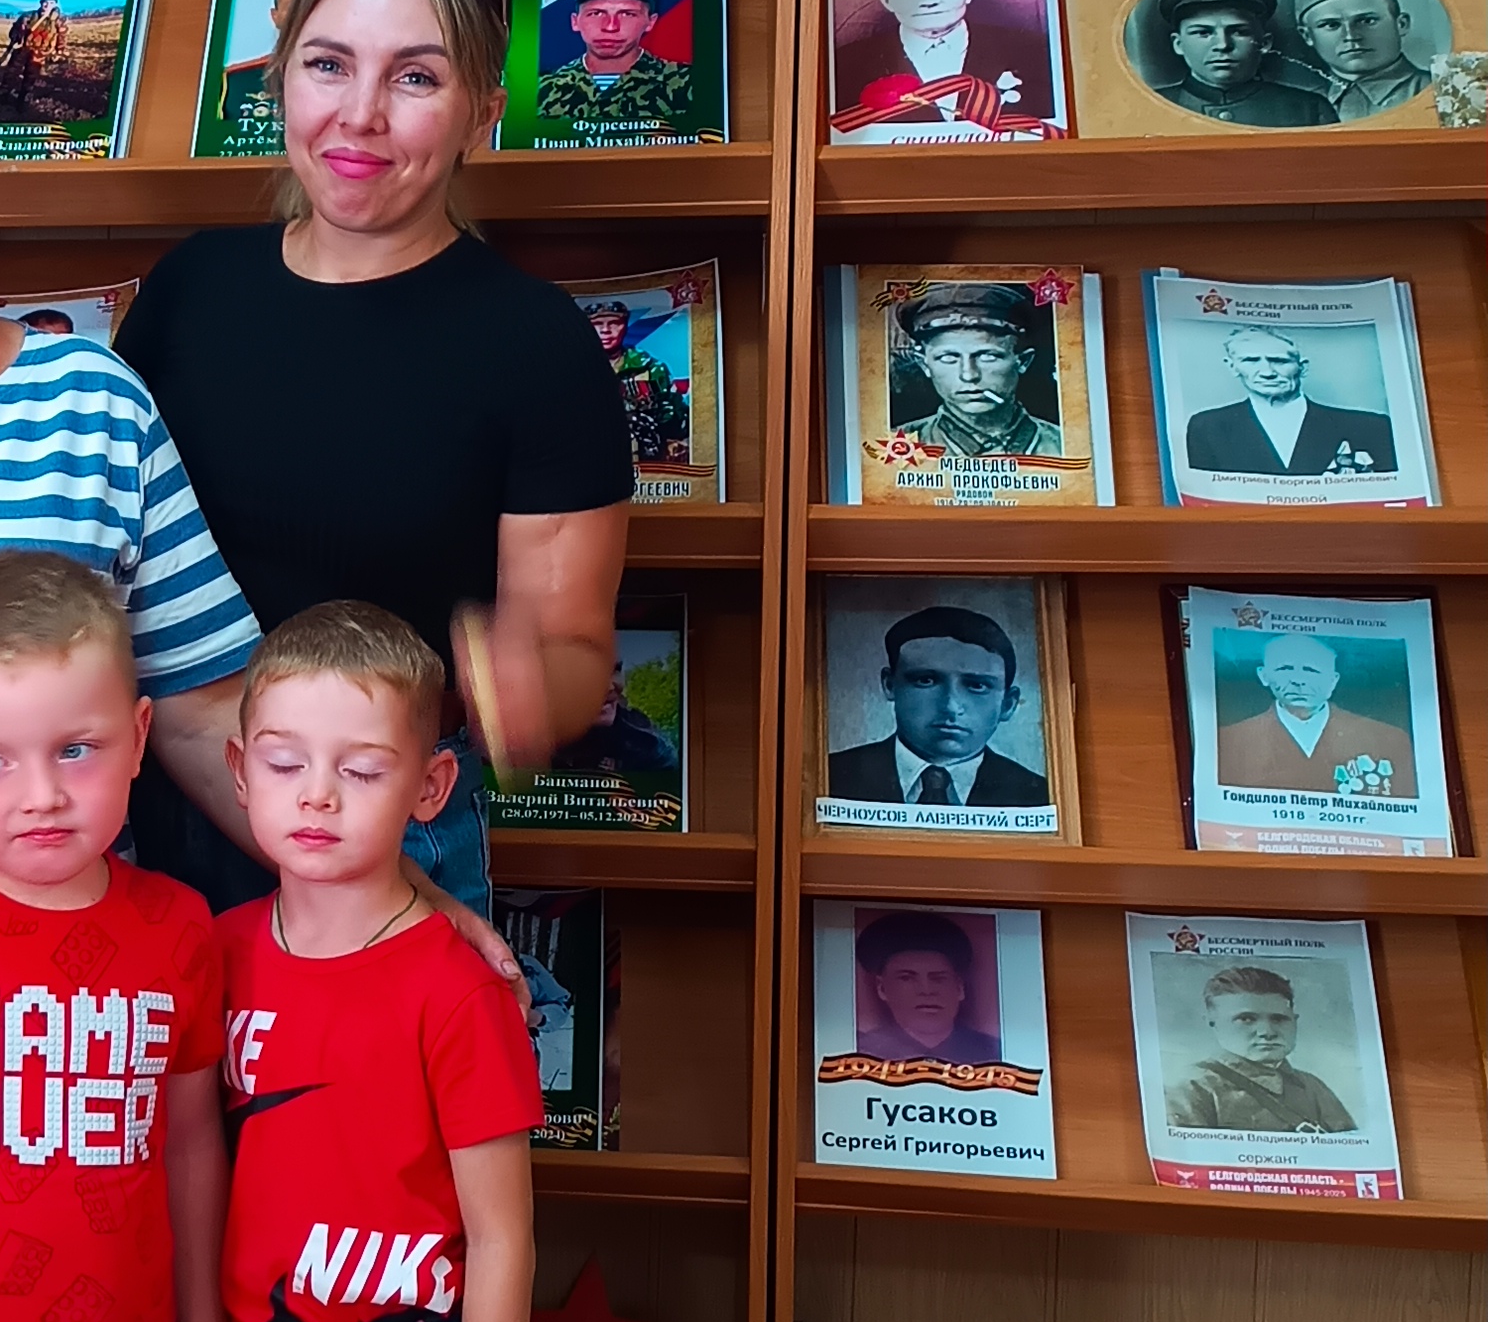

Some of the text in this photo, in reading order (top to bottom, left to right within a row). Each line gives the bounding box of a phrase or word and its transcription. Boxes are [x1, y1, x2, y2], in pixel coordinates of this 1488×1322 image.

[572, 119, 660, 134] Фурсенко
[223, 135, 277, 147] Артём
[534, 134, 699, 149] Иван Михайлович
[1235, 301, 1353, 311] БЕССМЕРТНЫЙ ПОЛК
[1236, 310, 1281, 318] РОССИИ
[940, 458, 1017, 472] МЕДВЕДЕВ
[897, 472, 1059, 489] АРХИП ПРОКОФЬЕВИЧ
[1212, 474, 1397, 487] Дмитриев Георгий Васильевич
[1267, 495, 1327, 505] рядовой
[1271, 614, 1387, 627] БЕССМЕРТНЫЙ ПОЛК
[1271, 623, 1316, 632] РОССИИ
[564, 794, 668, 809] Витальевич
[1223, 790, 1418, 814] Гондилов Пётр Михайлович
[817, 804, 907, 823] ЧЕРНОУСОВ
[1015, 814, 1055, 827] СЕРГ
[1272, 809, 1305, 820] 1918
[1258, 832, 1385, 848] БЕЛГОРОДСКАЯ ОБЛАСТЬ
[1208, 937, 1325, 949] БЕССМЕРТНЫЙ ПОЛК
[1209, 947, 1254, 955] РОССИИ
[834, 1060, 907, 1080] 1941
[941, 1064, 1017, 1087] 1945
[866, 1097, 998, 1127] Гусаков
[1247, 1133, 1308, 1144] Владимир
[1311, 1136, 1370, 1145] Иванович
[822, 1132, 1045, 1160] Сергей Григорьевич
[1238, 1154, 1299, 1165] сержант
[1208, 1170, 1288, 1184] БЕЛГОРОДСКАЯ
[1290, 1174, 1337, 1186] ОБЛАСТЬ
